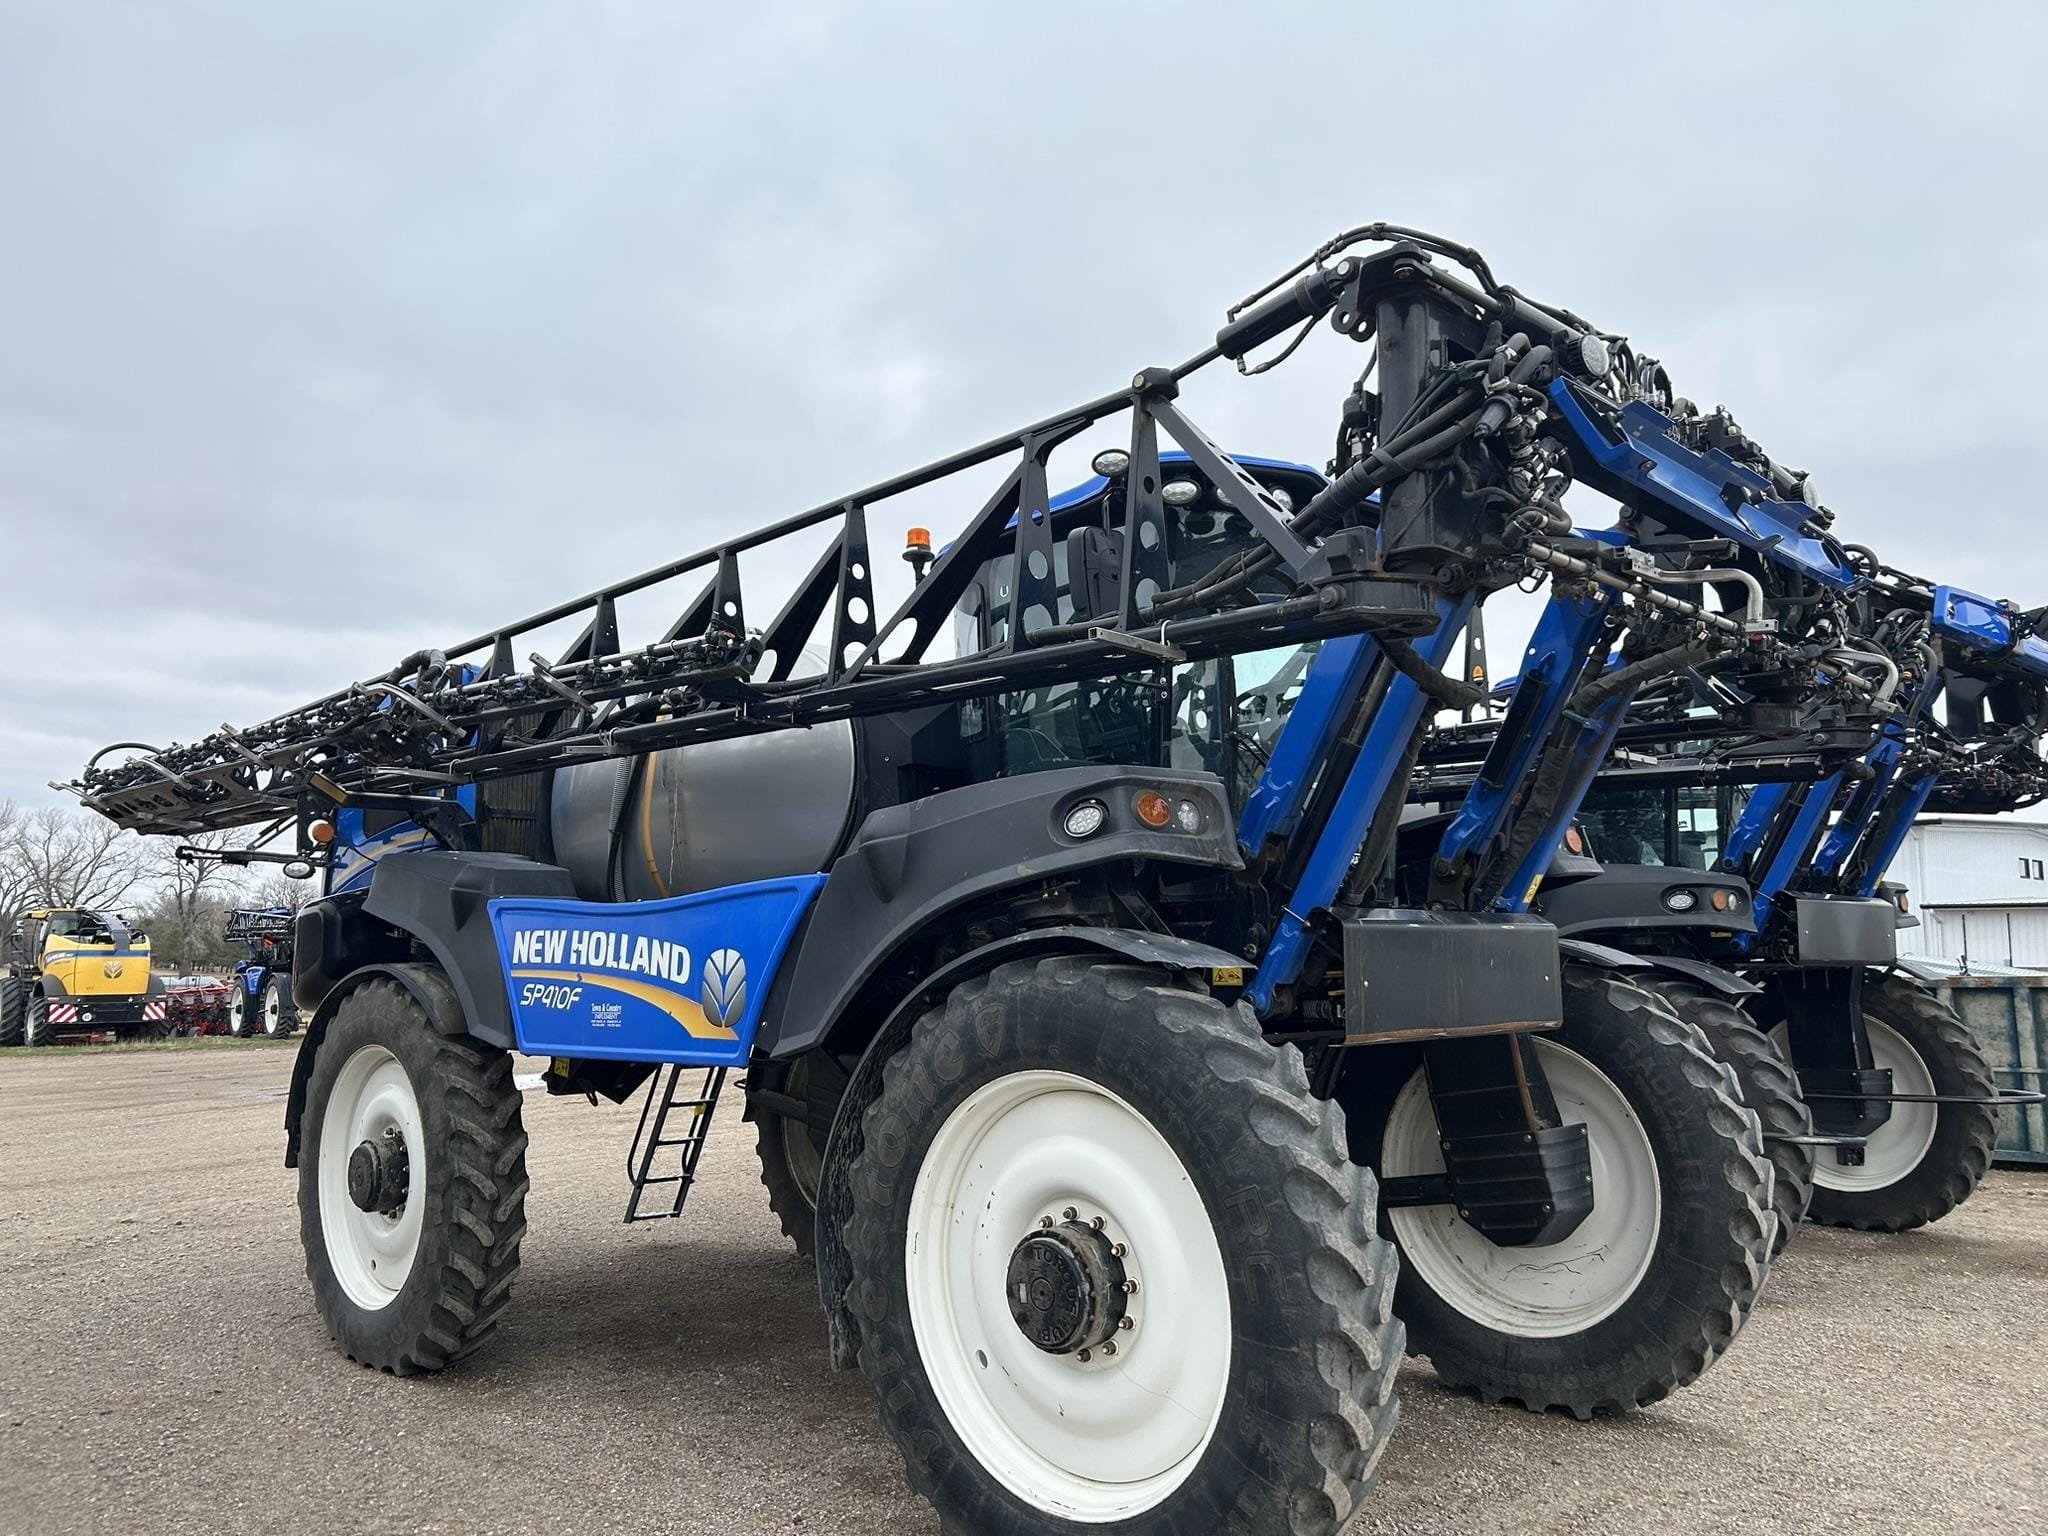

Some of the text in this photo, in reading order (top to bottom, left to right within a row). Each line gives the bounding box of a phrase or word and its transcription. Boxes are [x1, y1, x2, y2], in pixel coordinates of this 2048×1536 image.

[512, 930, 691, 985] NEW HOLLAND
[520, 983, 583, 1011] SP410F
[1032, 1247, 1079, 1315] TORQUE
